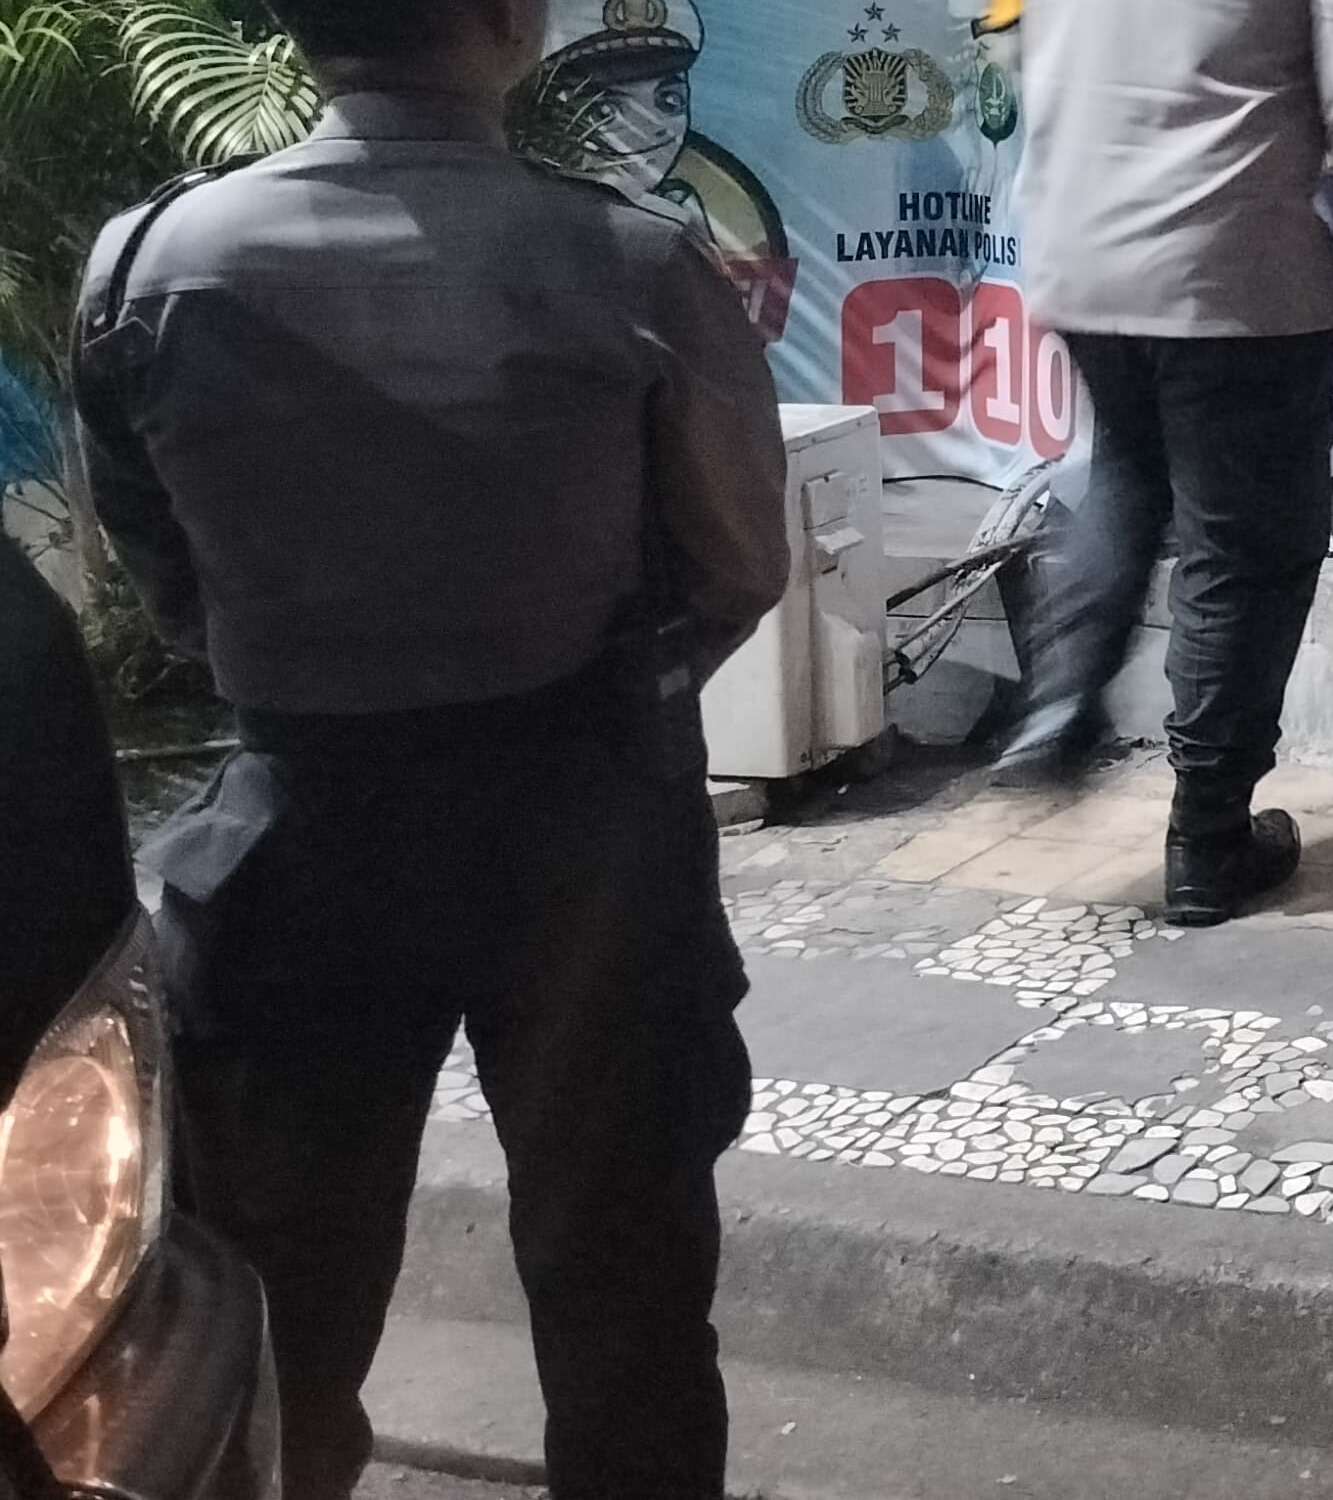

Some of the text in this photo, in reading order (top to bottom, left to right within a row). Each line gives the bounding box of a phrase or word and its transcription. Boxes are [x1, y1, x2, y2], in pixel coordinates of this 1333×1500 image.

[899, 191, 992, 225] HOTLINE
[837, 228, 969, 262] LAYANAN
[872, 309, 1073, 441] 110
